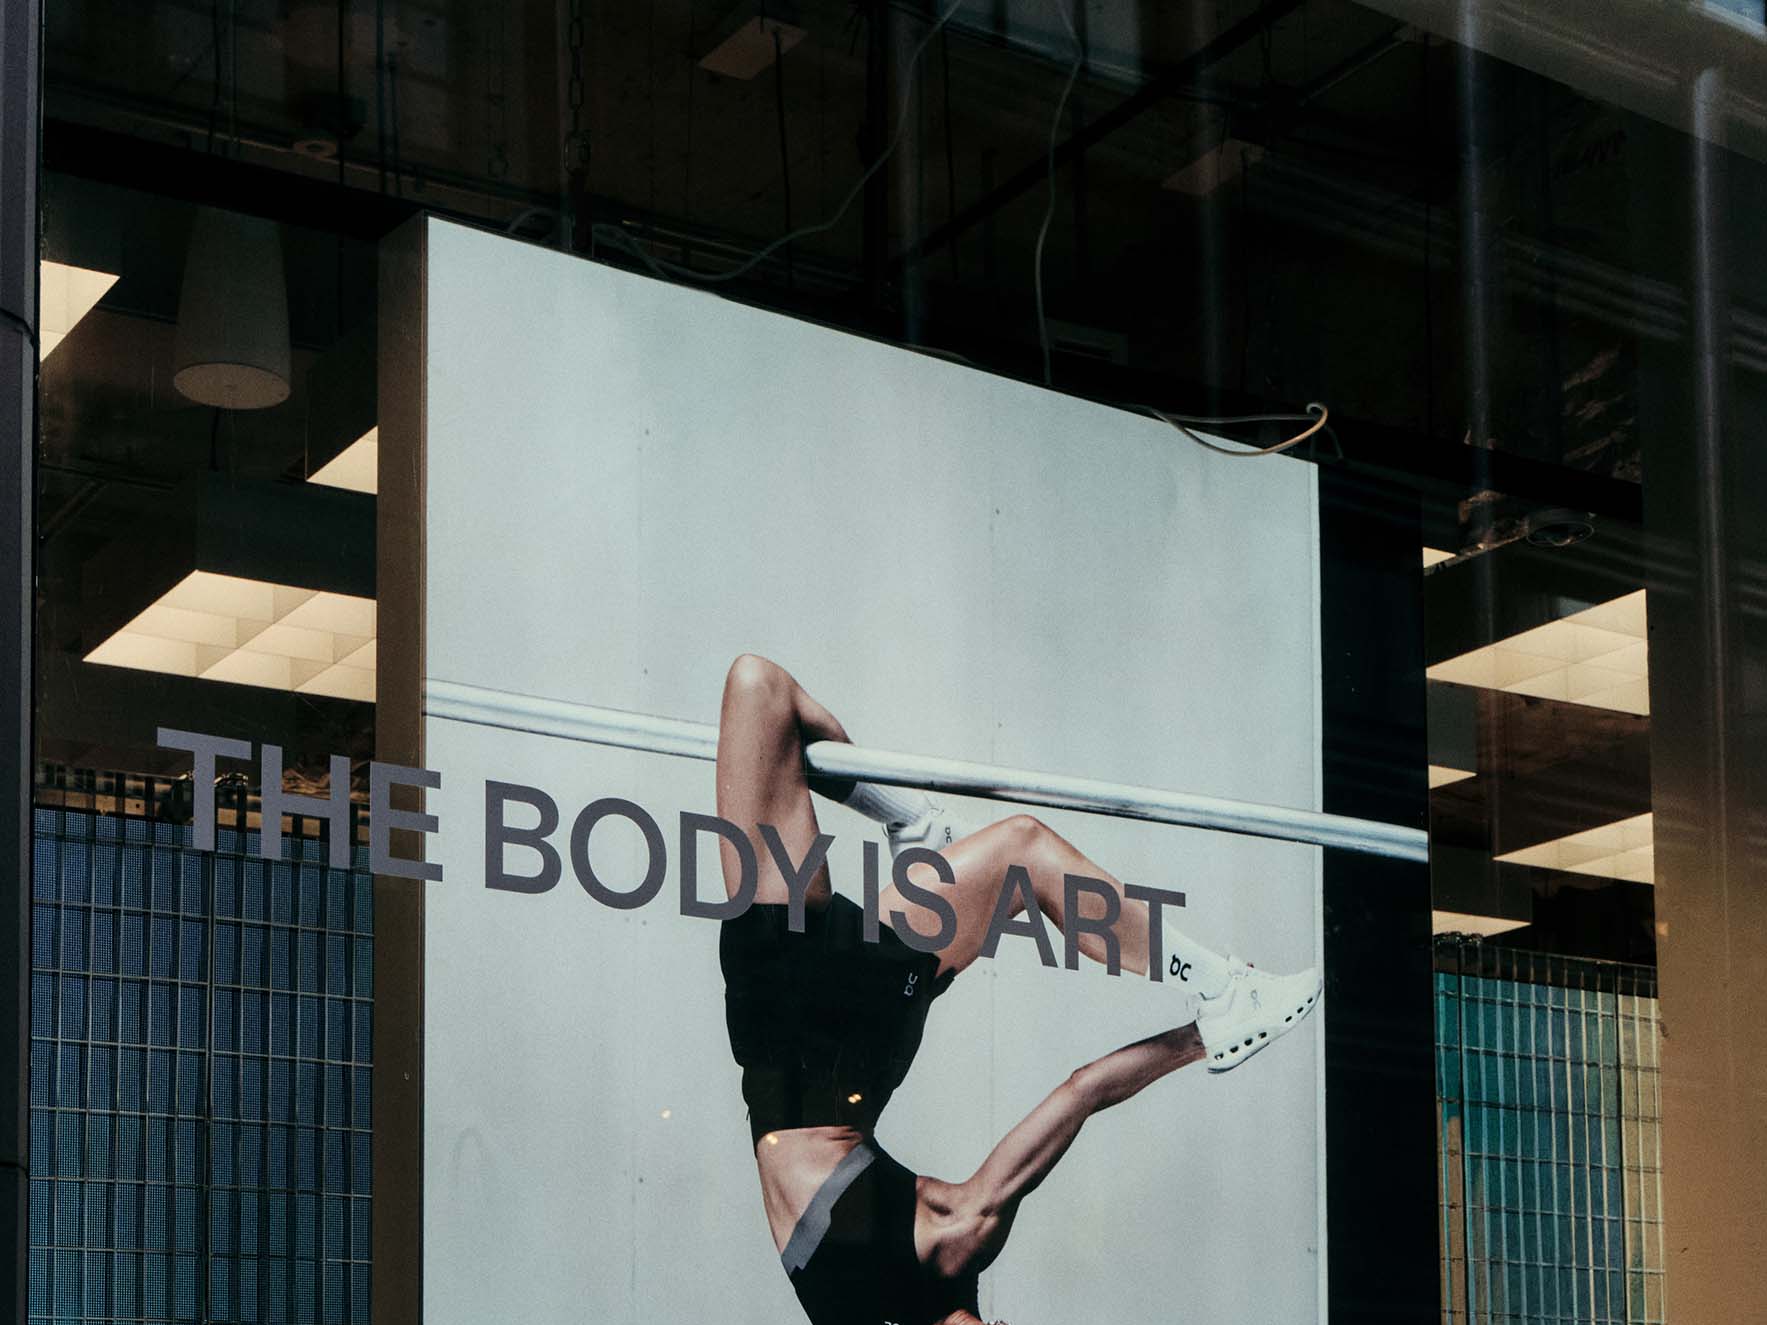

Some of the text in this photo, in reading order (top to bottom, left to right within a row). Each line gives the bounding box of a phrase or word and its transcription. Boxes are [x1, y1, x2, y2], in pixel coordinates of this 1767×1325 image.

[156, 726, 1187, 983] THE BODY IS ART
